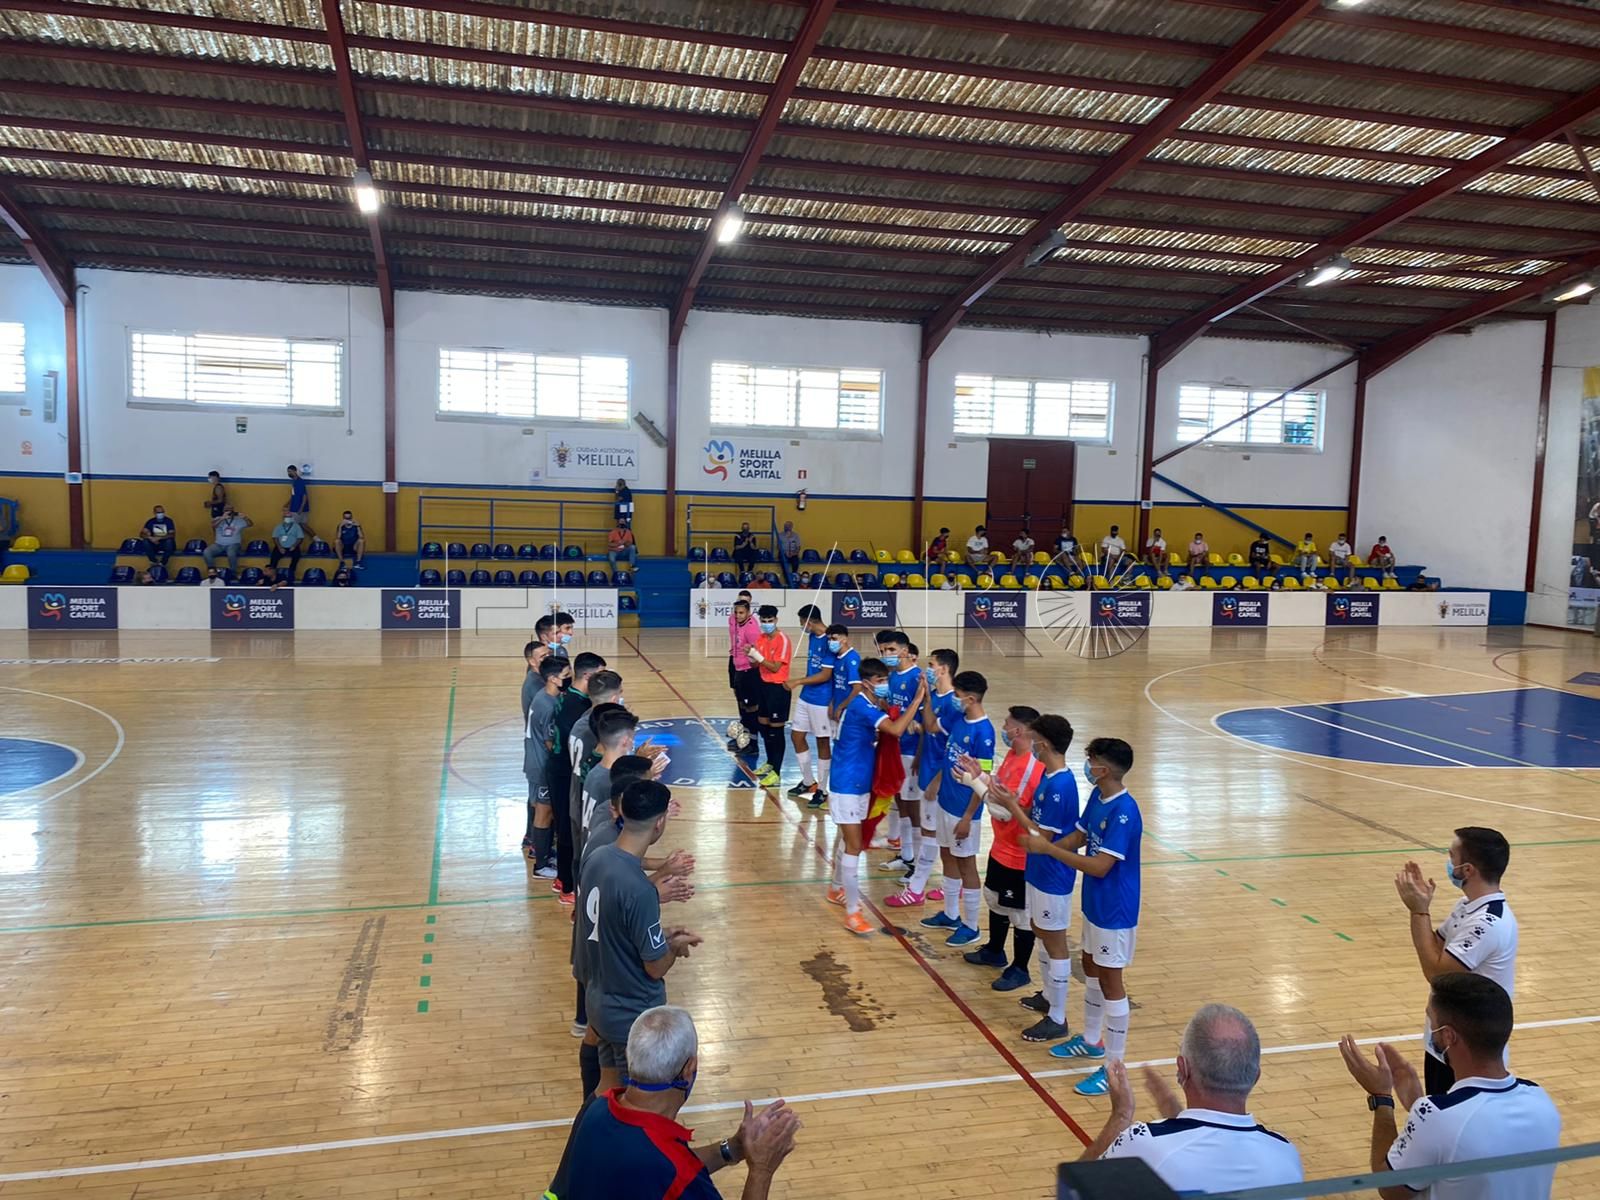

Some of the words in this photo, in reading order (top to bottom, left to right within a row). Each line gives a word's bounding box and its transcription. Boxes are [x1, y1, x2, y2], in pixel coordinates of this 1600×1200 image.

[740, 449, 782, 459] MELILLA
[577, 453, 635, 467] MELILLA
[739, 459, 774, 469] SPORT
[739, 469, 782, 479] CAPITAL
[567, 608, 615, 618] MELILLA
[1452, 607, 1487, 616] MELILLA
[586, 886, 600, 943] 9
